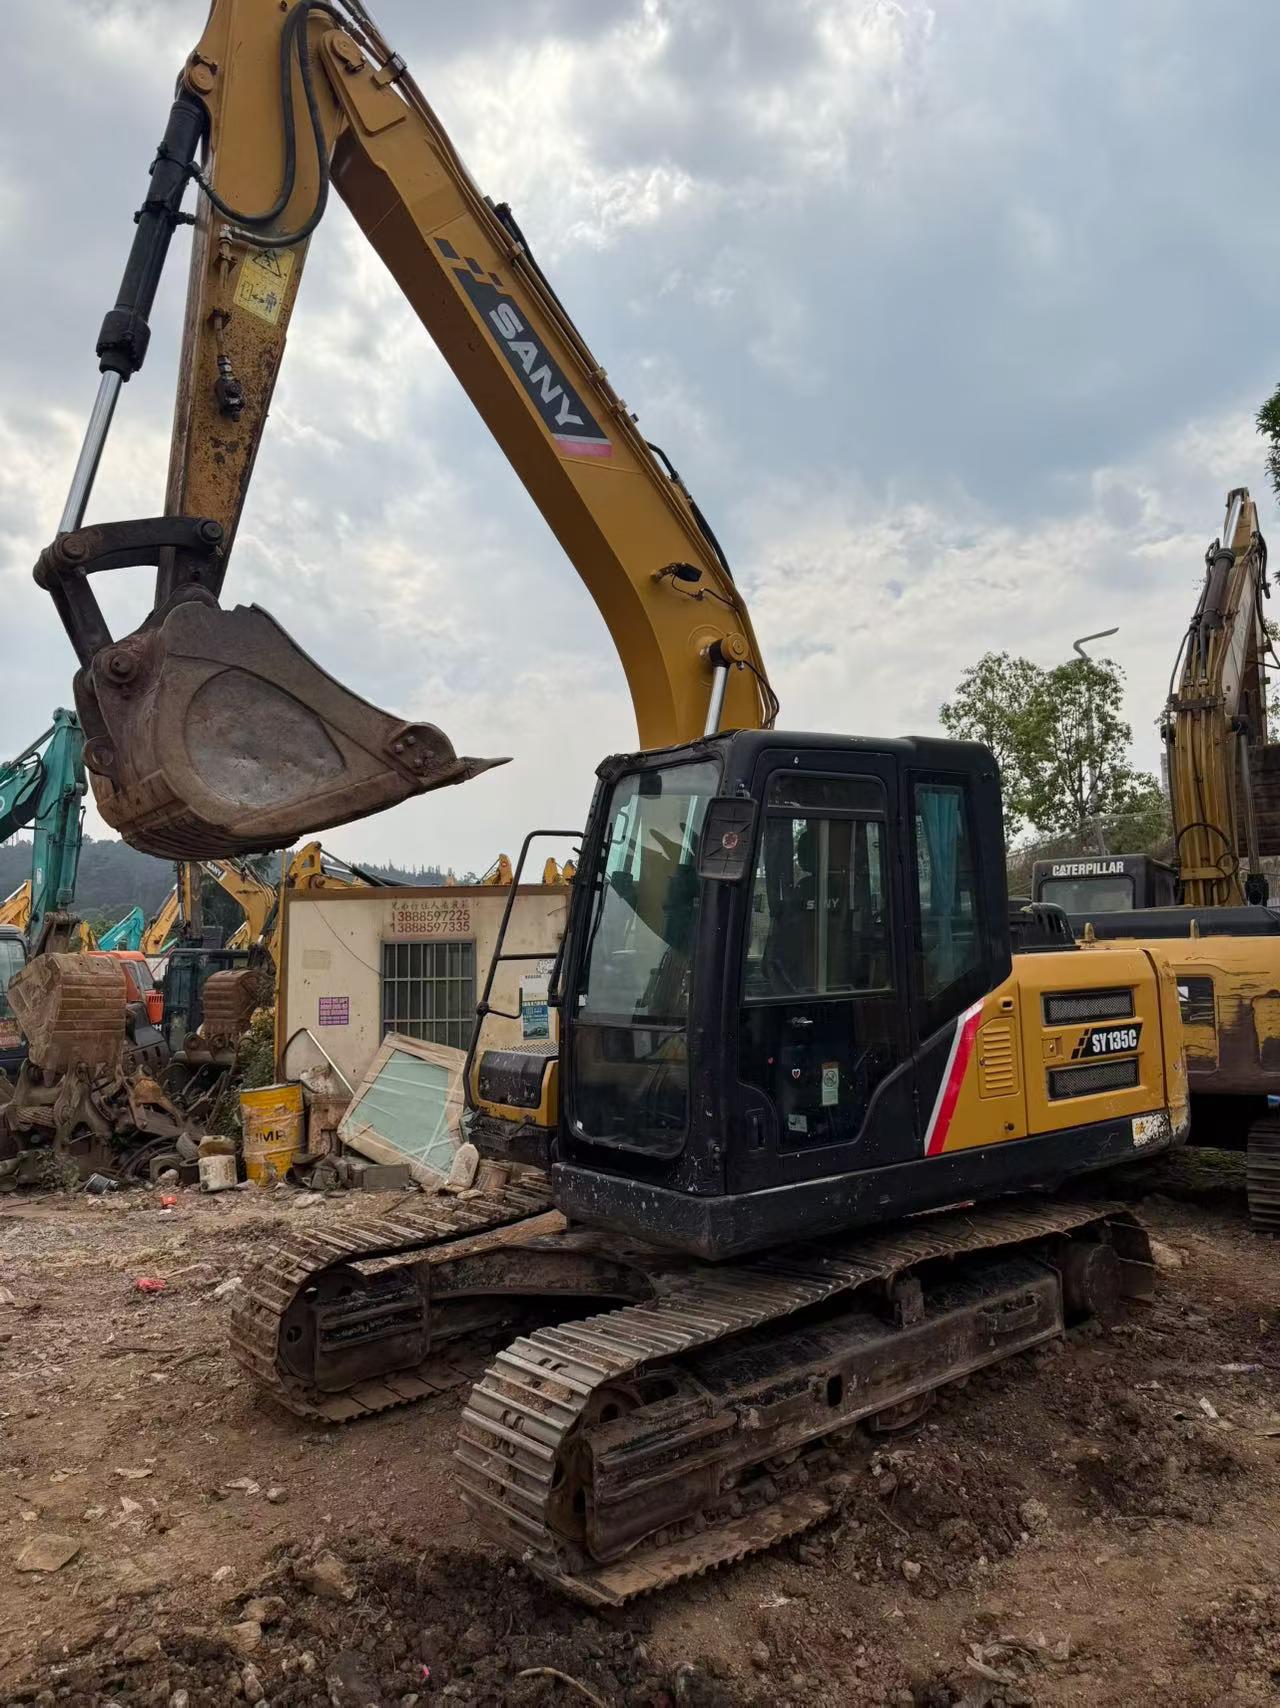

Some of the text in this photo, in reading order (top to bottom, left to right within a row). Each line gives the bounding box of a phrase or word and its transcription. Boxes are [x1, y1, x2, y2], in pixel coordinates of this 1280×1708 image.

[489, 303, 584, 426] SANY
[1052, 861, 1124, 876] CATERPILLAR
[806, 898, 840, 910] SNY
[391, 910, 470, 921] 13888597225
[390, 921, 471, 933] 13888597335
[1092, 1029, 1137, 1053] SY135C
